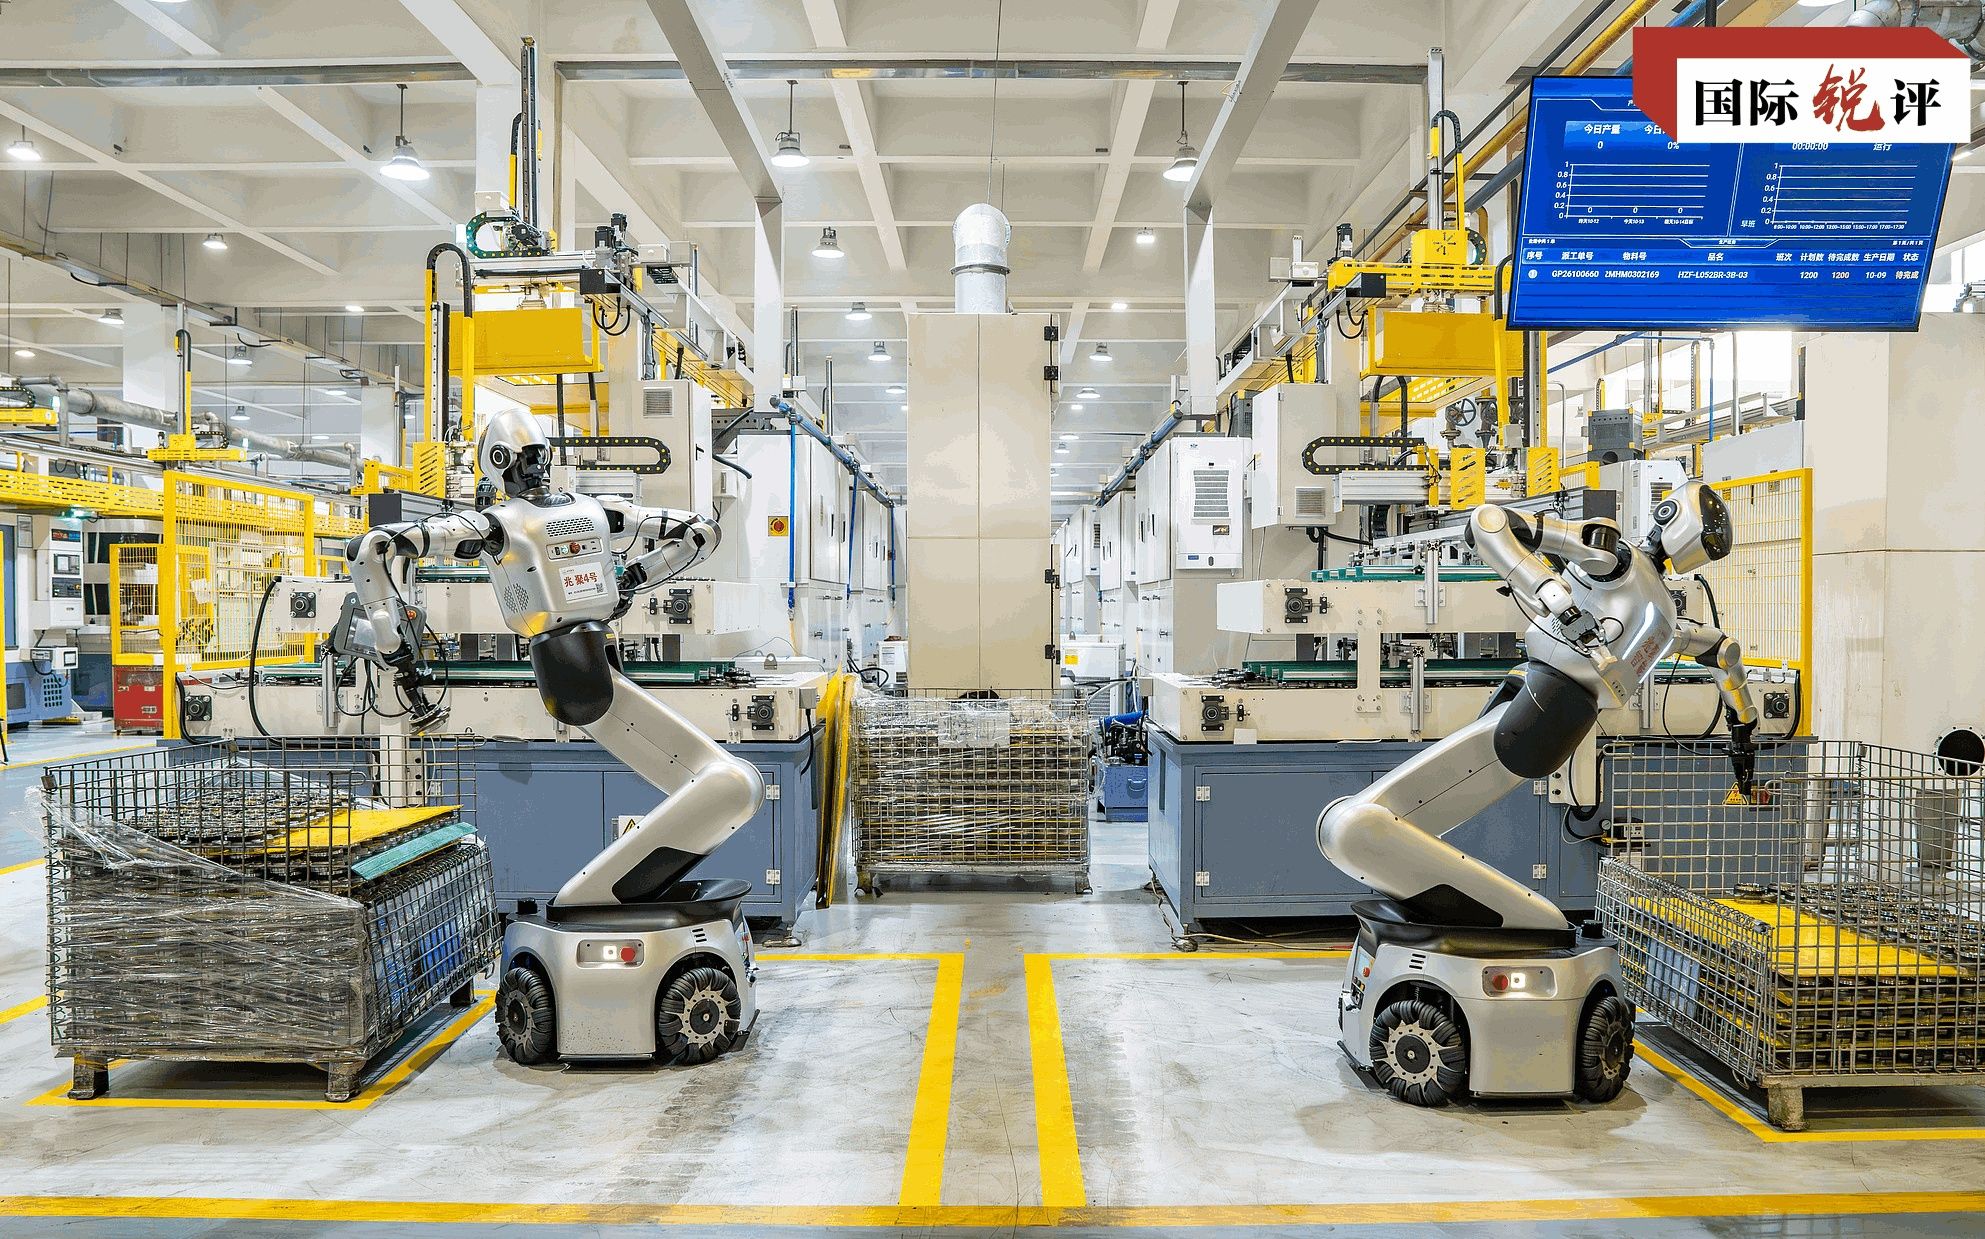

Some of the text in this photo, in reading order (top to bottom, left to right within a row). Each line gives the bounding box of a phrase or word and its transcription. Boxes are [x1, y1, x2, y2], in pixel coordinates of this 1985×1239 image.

[1584, 124, 1621, 135] 今日产量
[1597, 140, 1604, 149] 0
[1667, 141, 1680, 150] 0%
[1792, 143, 1829, 151] 00:00:00
[1556, 181, 1567, 189] 0.6
[1764, 184, 1775, 192] 0.6
[1632, 206, 1638, 214] 0
[1677, 206, 1683, 214] 0
[1525, 251, 1920, 262] 序号 派工单号 物料号 品名 班次 计划数 待完成数 生产日期 状态
[1551, 270, 1600, 278] GP26100660
[1800, 271, 1818, 279] 1200
[1831, 271, 1850, 279] 1200
[1865, 271, 1887, 279] 10-09
[1895, 270, 1919, 280] 待完成
